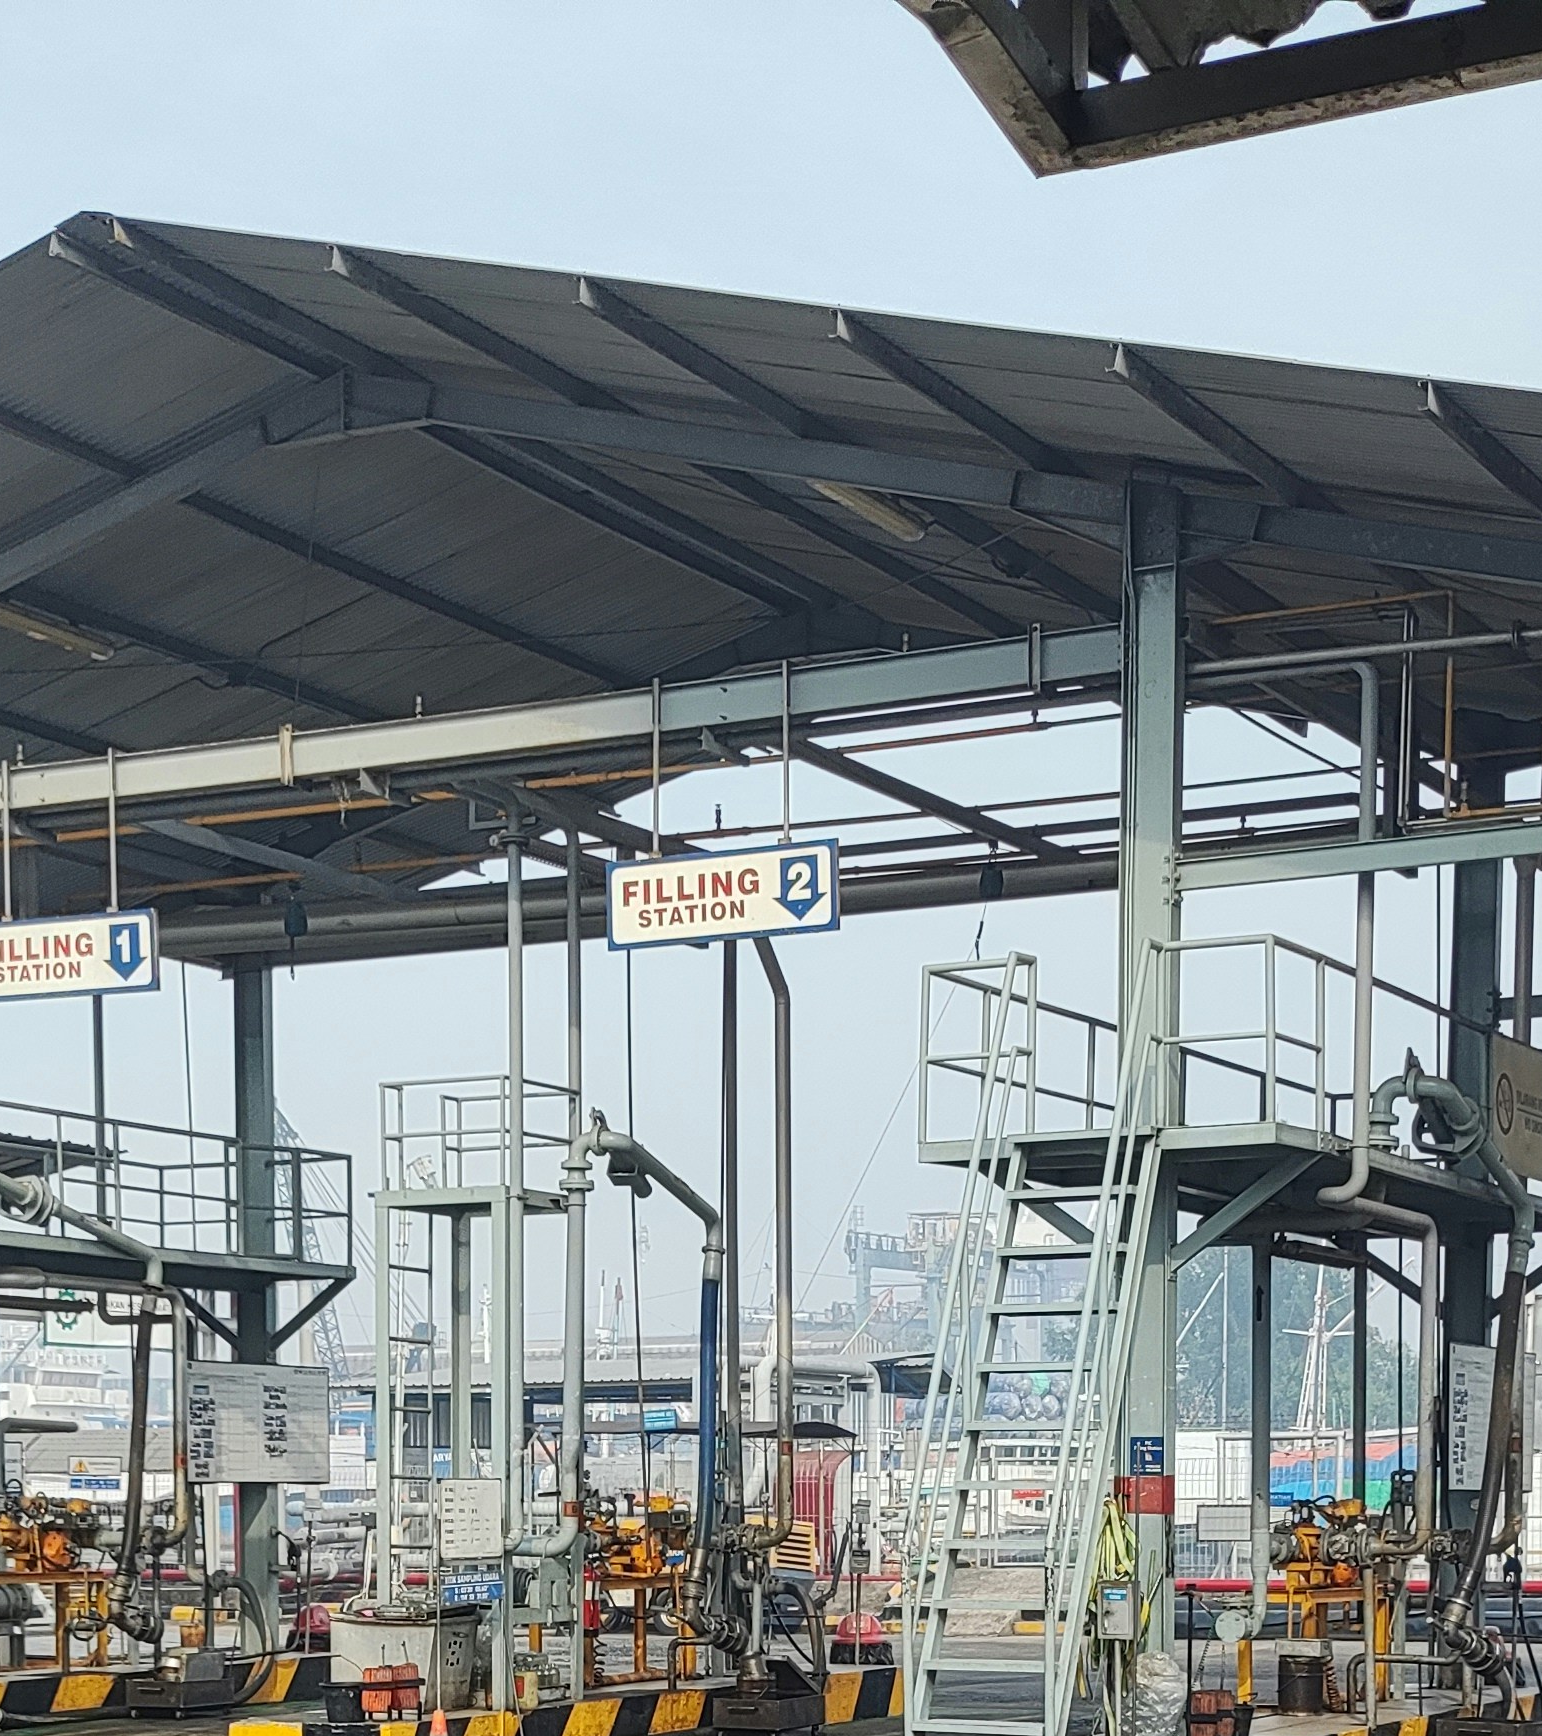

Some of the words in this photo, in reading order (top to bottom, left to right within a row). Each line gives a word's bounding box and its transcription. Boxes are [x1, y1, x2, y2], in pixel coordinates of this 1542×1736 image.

[622, 868, 760, 907] FILLING
[786, 861, 812, 901] 2
[638, 900, 745, 928] STATION
[115, 928, 131, 963] 1
